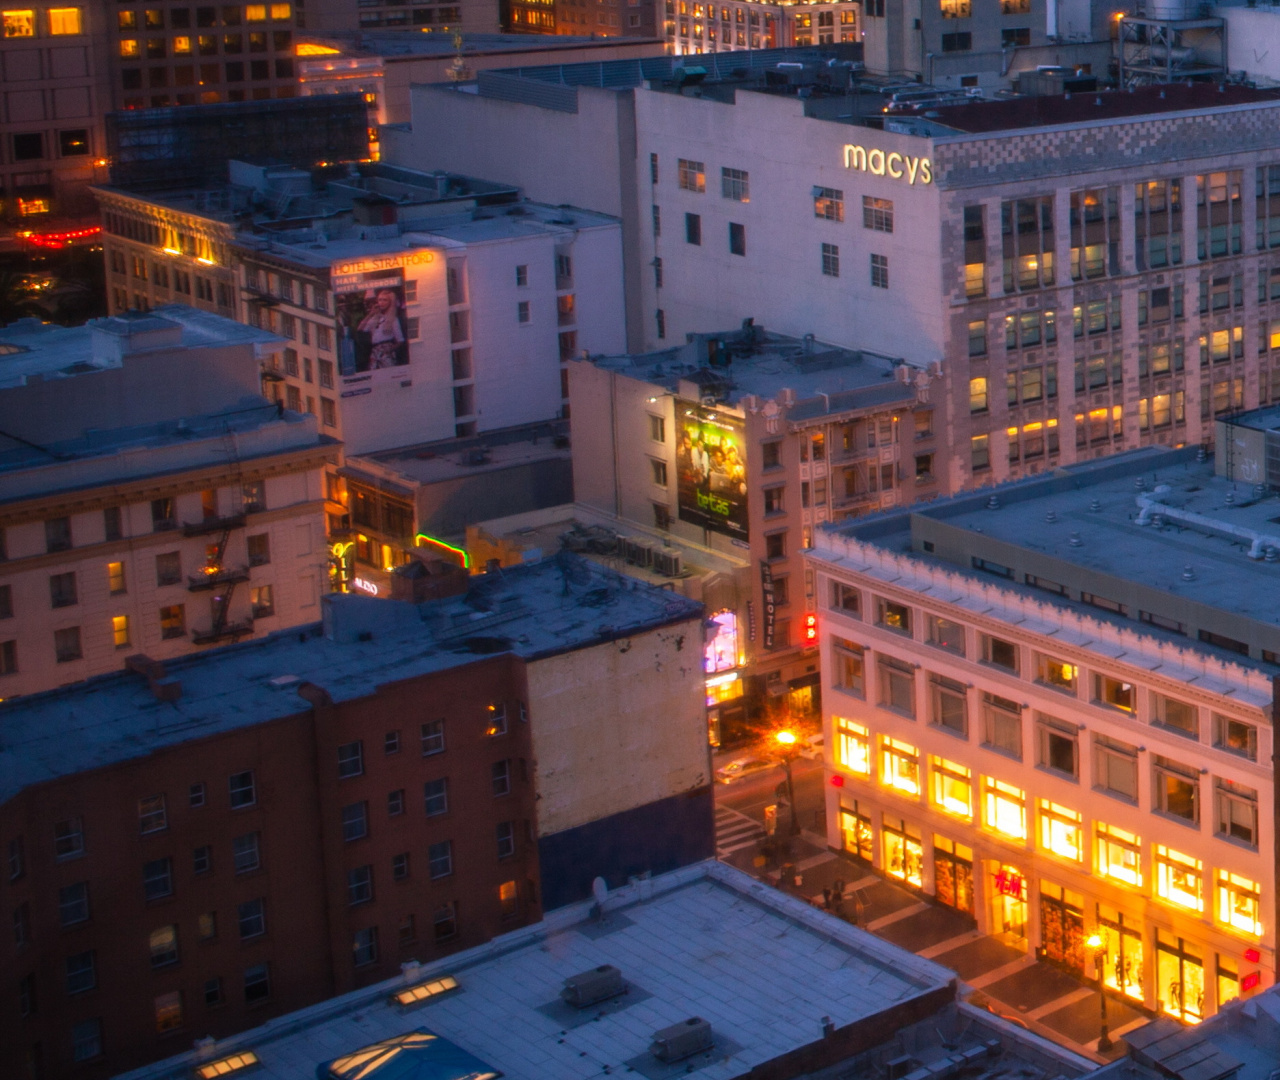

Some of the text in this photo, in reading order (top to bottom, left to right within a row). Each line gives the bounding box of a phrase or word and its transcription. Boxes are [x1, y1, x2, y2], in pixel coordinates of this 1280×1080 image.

[843, 144, 932, 185] macys
[334, 252, 434, 275] HOTEL STRATFORD
[696, 488, 730, 516] betas
[766, 593, 775, 646] HOTEL
